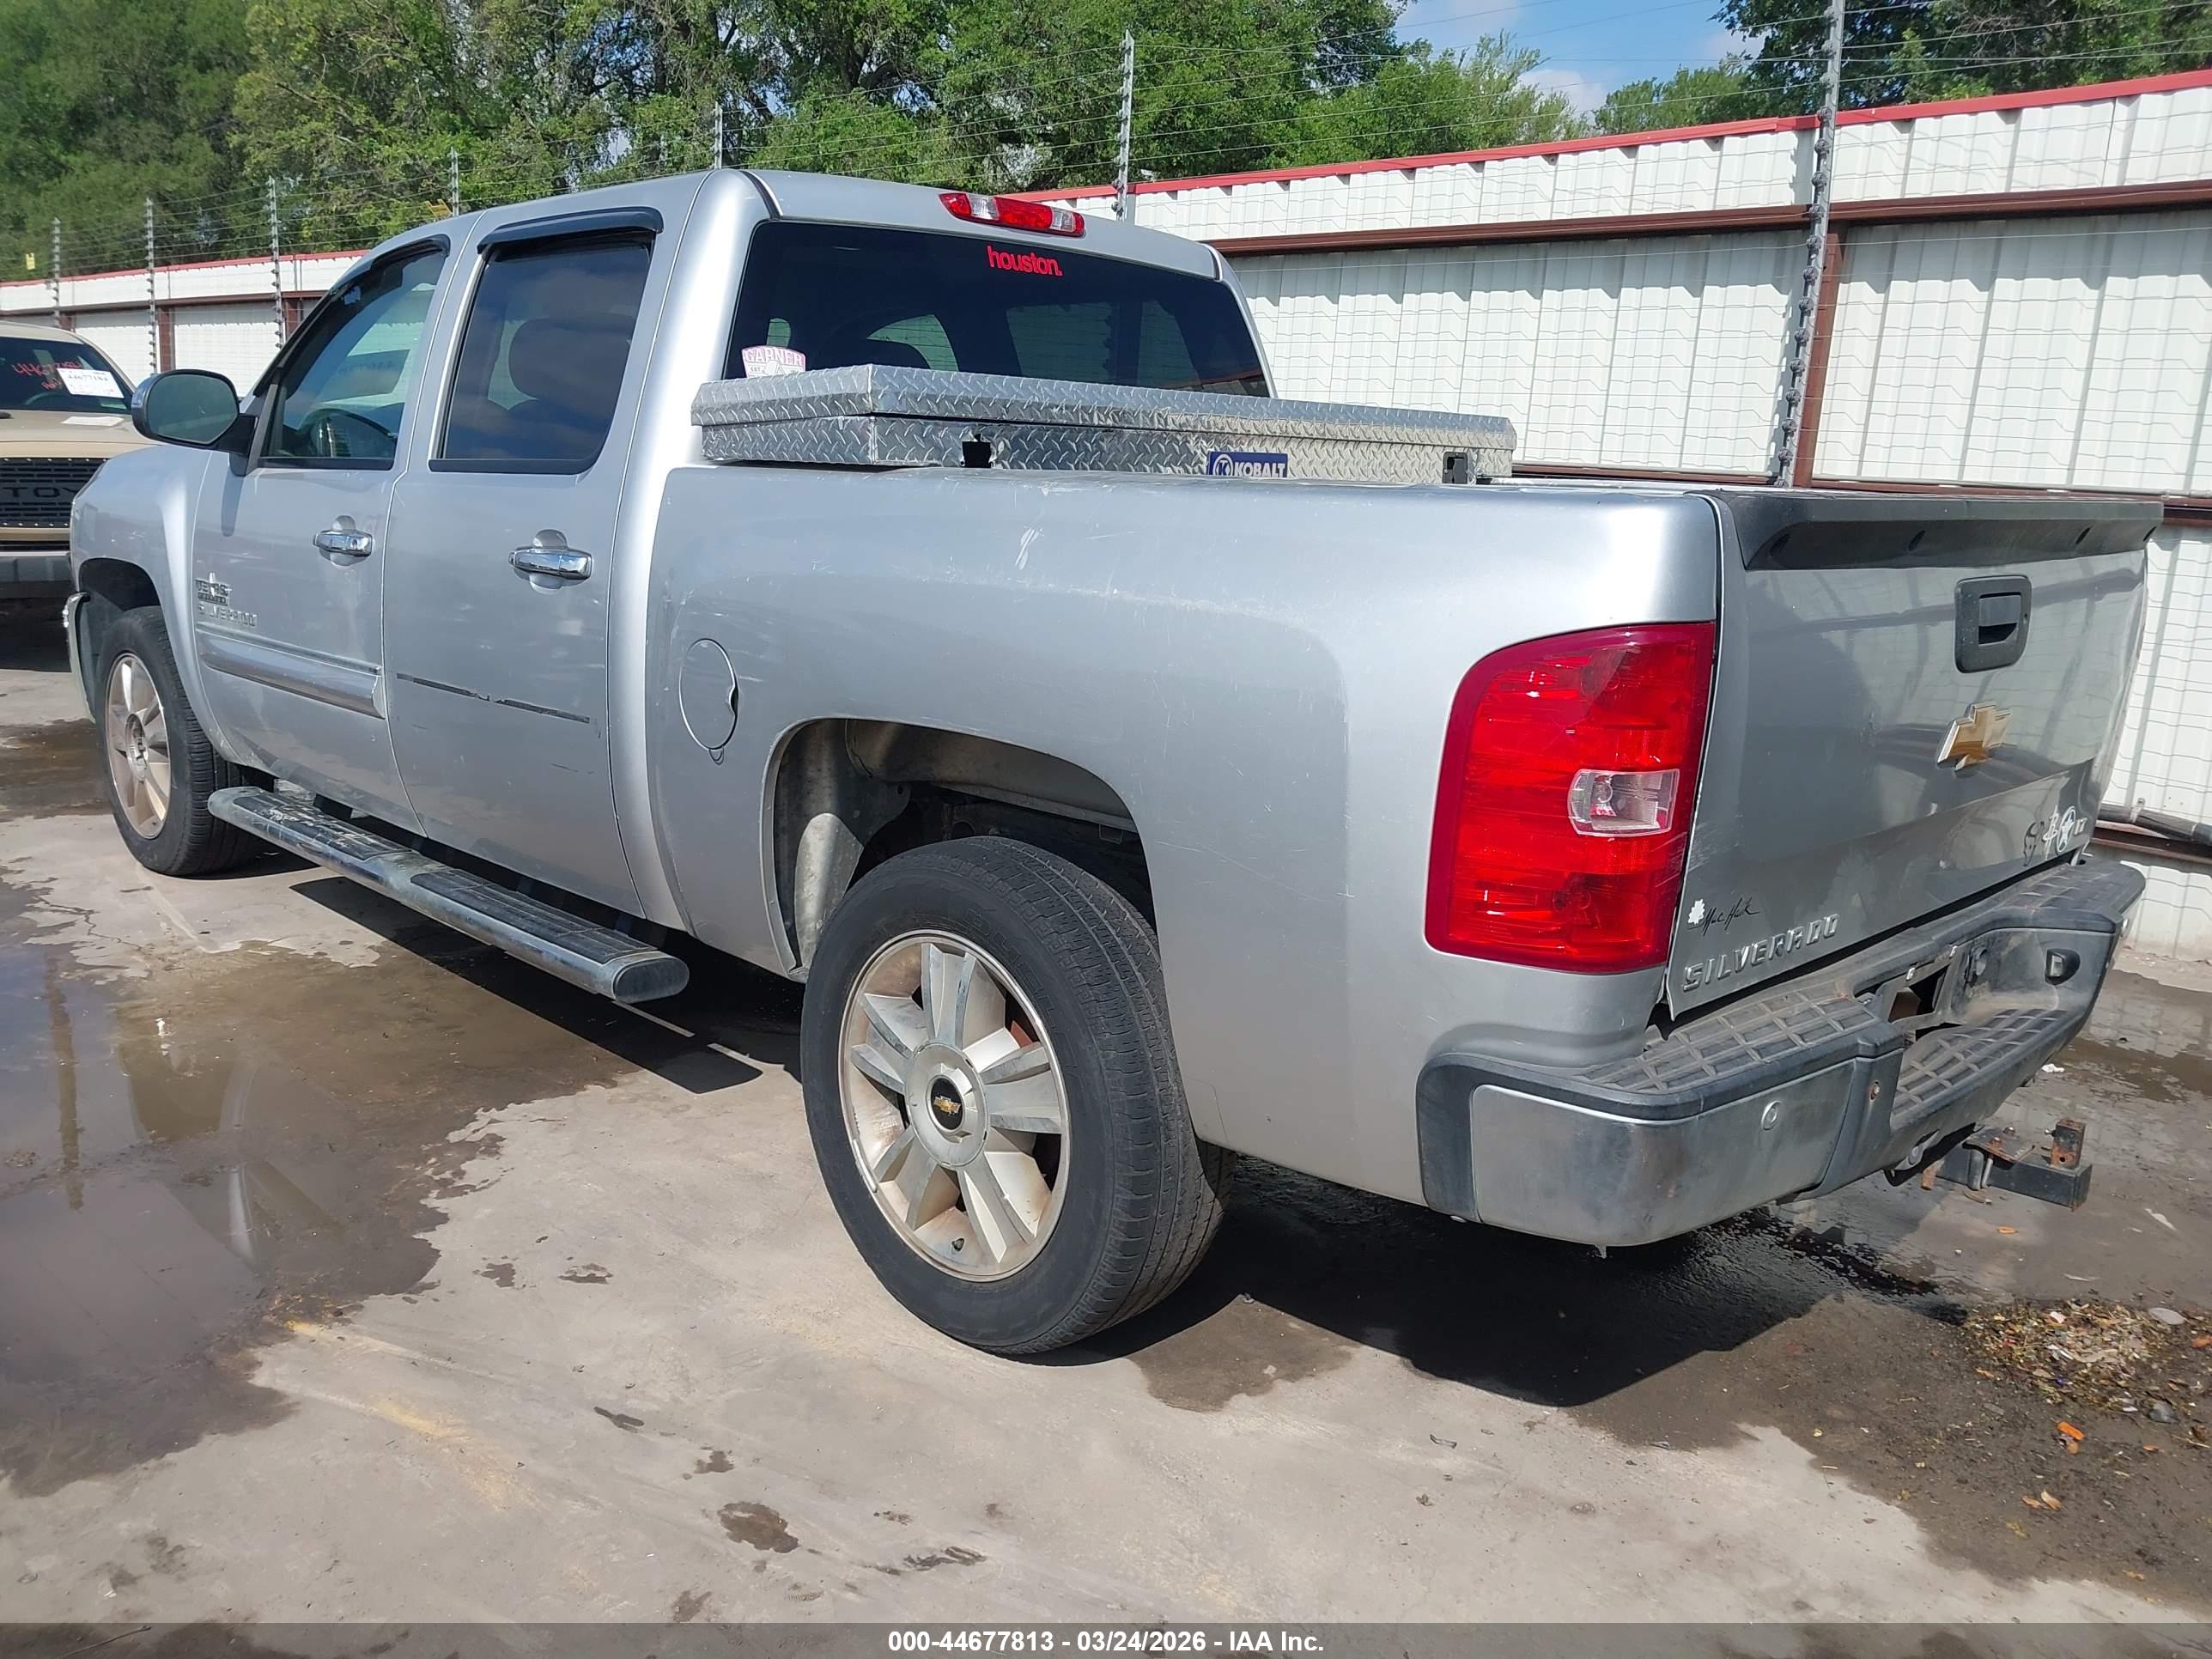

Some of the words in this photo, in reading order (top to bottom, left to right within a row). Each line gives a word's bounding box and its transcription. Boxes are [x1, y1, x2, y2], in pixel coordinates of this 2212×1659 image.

[745, 346, 803, 367] GARNER
[1234, 461, 1285, 478] KOBALT
[1682, 913, 1841, 992] SILVERADO
